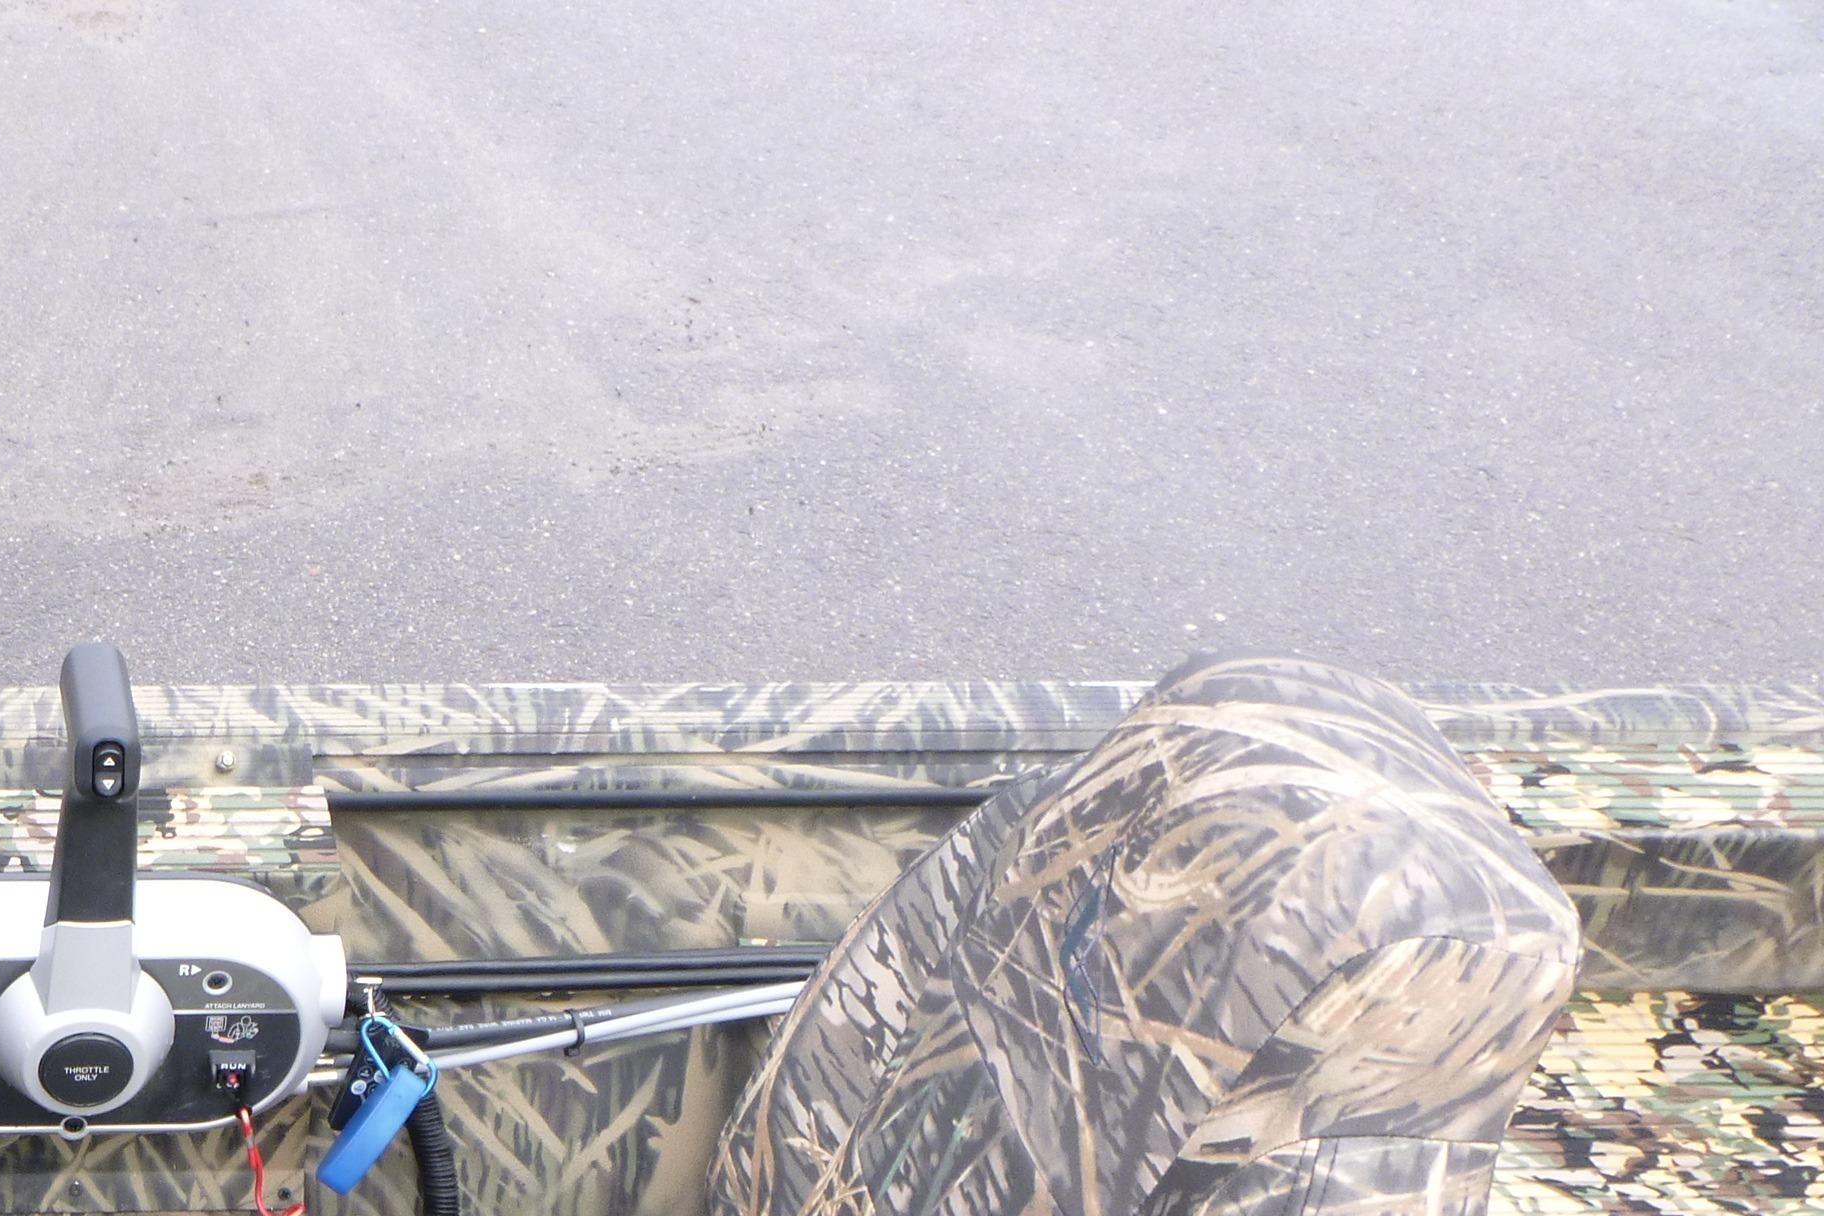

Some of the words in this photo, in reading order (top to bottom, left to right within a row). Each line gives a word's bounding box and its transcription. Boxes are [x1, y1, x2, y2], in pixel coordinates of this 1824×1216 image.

[179, 964, 190, 976] R
[63, 1065, 111, 1075] THROTTLE
[74, 1073, 99, 1082] ONLY
